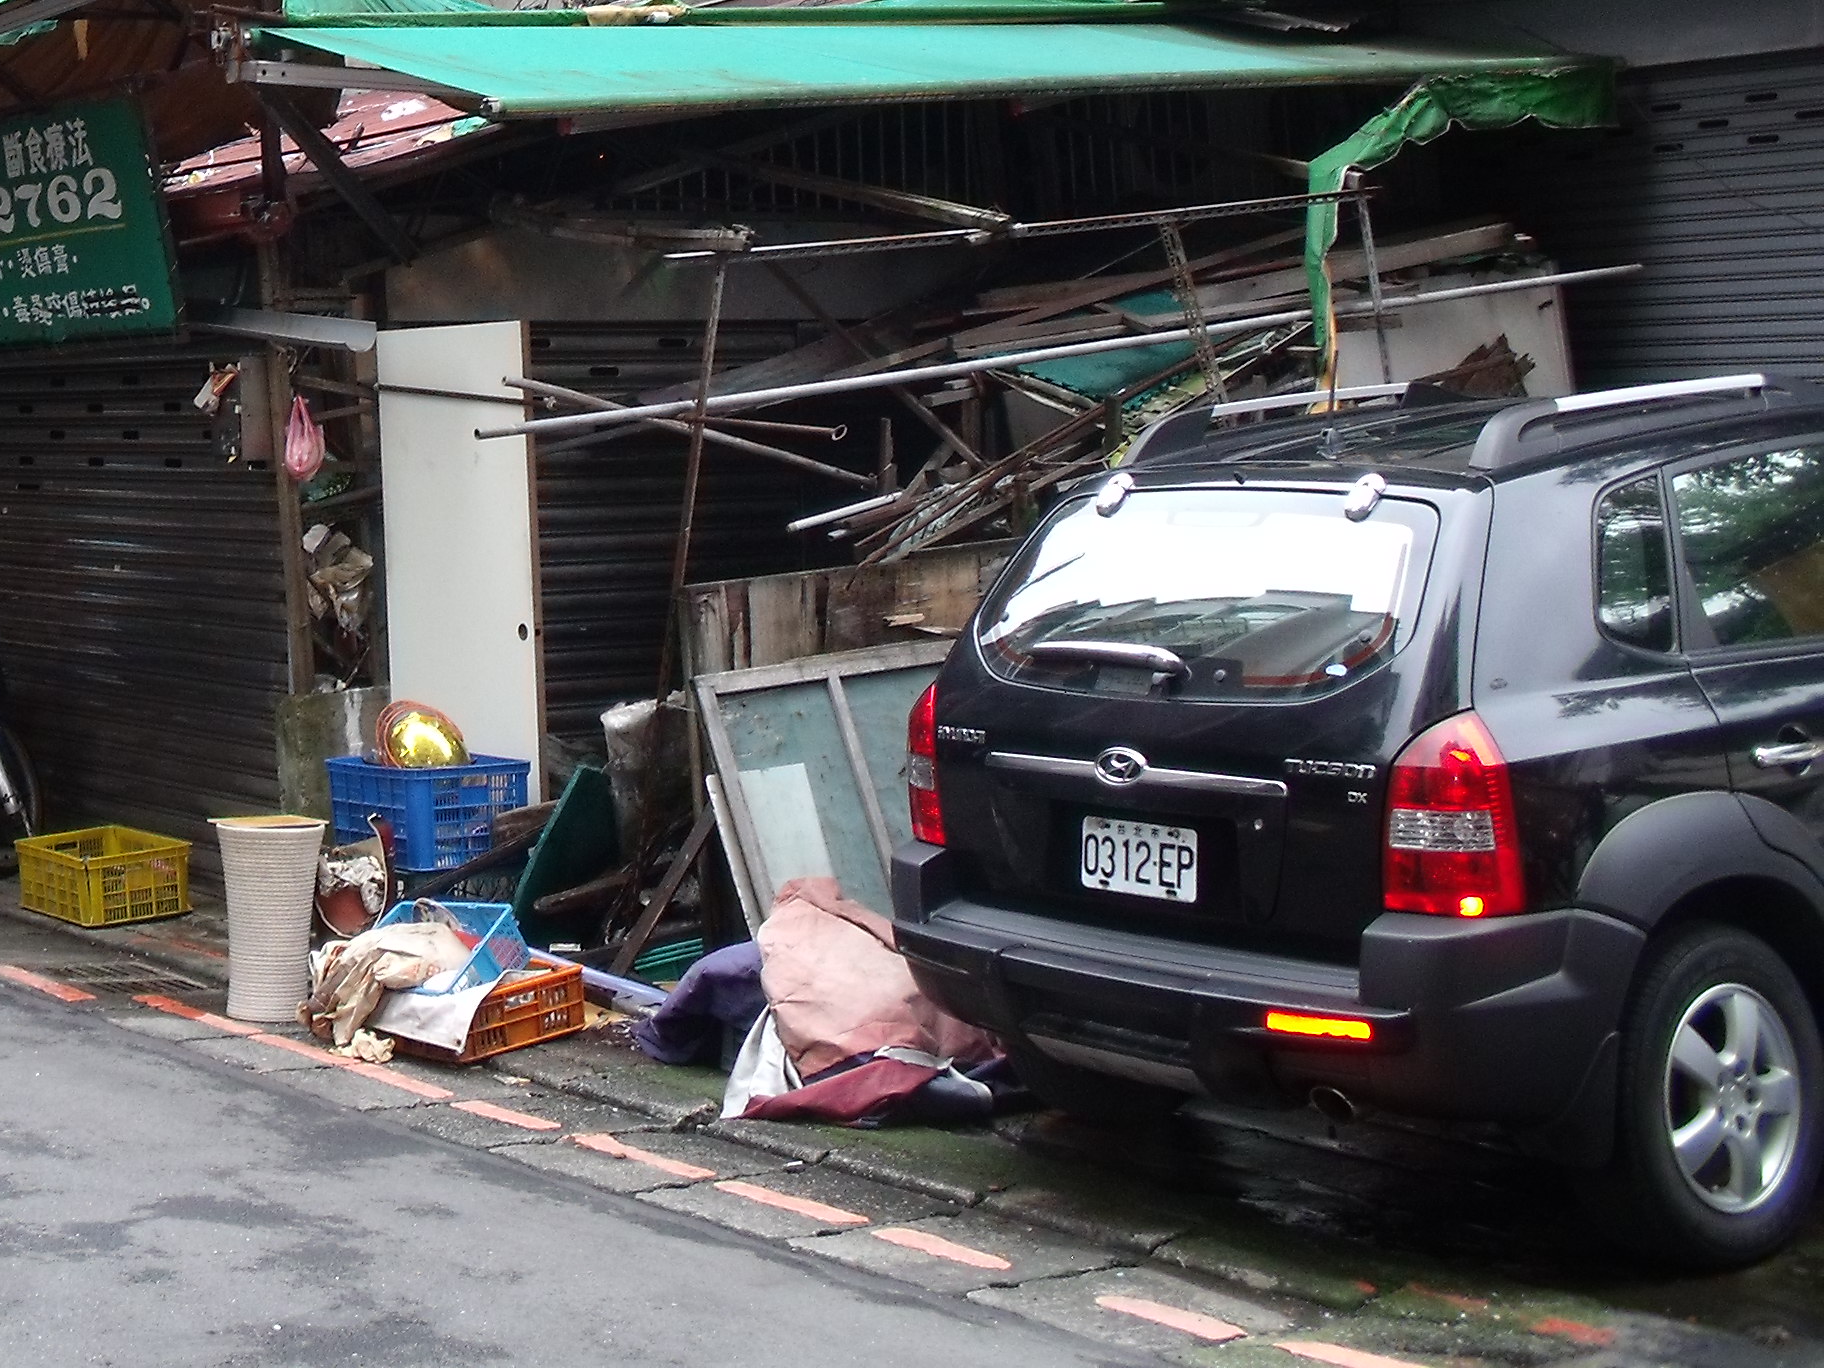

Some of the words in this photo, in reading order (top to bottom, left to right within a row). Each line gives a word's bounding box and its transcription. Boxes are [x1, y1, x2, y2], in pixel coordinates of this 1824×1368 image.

[2, 117, 95, 179] 斷食療法
[1084, 833, 1195, 890] 0312-EP
